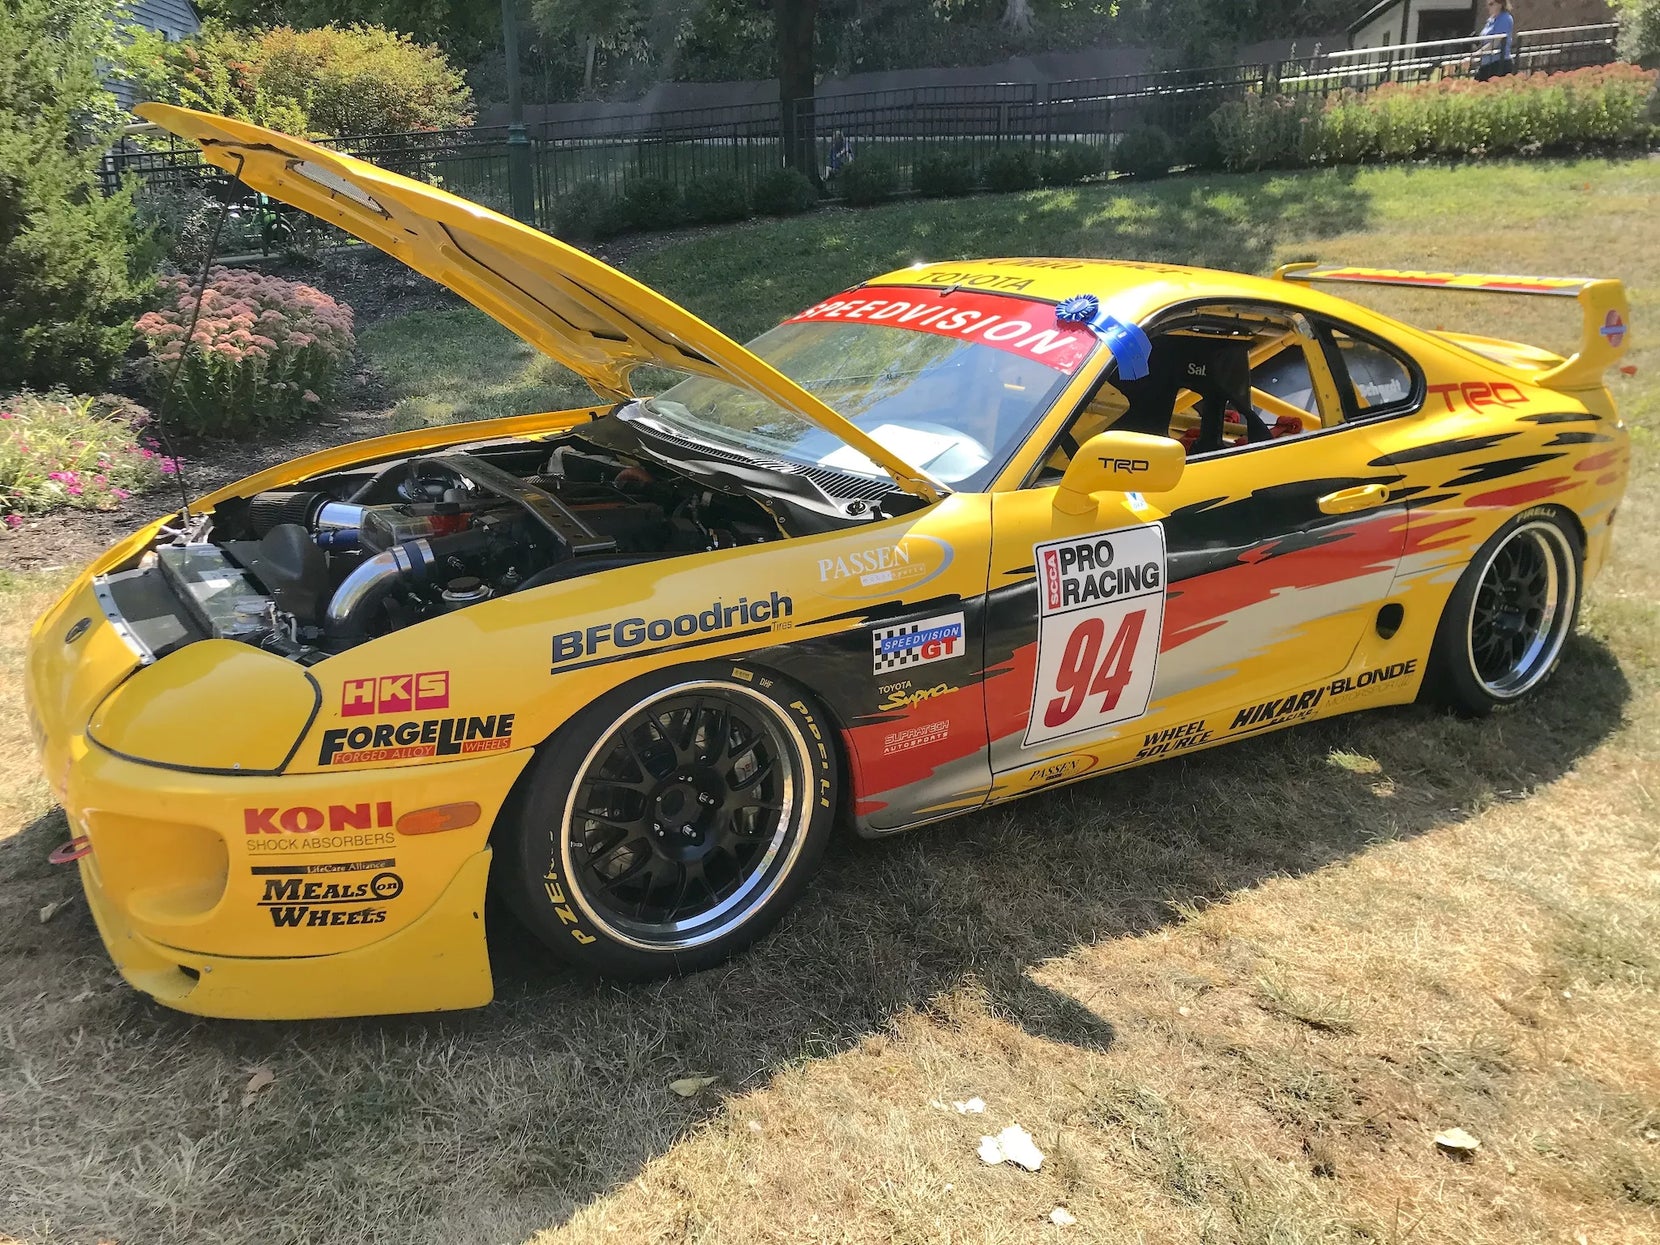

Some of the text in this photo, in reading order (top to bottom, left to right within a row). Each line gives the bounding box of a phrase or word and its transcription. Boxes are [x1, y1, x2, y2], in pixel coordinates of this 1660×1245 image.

[916, 272, 1036, 291] TOYOTA
[796, 300, 1078, 356] SPEEDVISION
[1428, 382, 1530, 414] TRD
[1098, 457, 1149, 474] TRD
[1516, 507, 1557, 523] PIRELLI
[817, 542, 910, 582] PASSEN
[1059, 540, 1114, 575] PRO
[1047, 552, 1060, 606] SCCA
[1062, 561, 1160, 606] RACING
[552, 591, 793, 664] BFGoodrich
[771, 620, 793, 632] Tires
[884, 626, 960, 651] SPEEDVISION
[921, 636, 957, 659] GT
[1044, 608, 1147, 728] 94
[1330, 659, 1417, 696] BLONDE
[342, 672, 449, 714] HKS
[878, 680, 912, 694] TOYOTA
[878, 683, 959, 709] Supra
[1229, 687, 1325, 730] HIKARI
[318, 713, 516, 766] FORGELINE
[884, 731, 949, 753] AUTOSPORTS
[1135, 730, 1214, 758] SOURCE
[1143, 720, 1205, 747] WHEEL
[335, 739, 509, 764] FORGED ALLOY WHEELS
[1029, 759, 1080, 781] PASSEN
[244, 801, 393, 835] KONI
[246, 832, 395, 851] SHOCK ABSORBERS
[262, 878, 368, 900] MEALS
[269, 906, 387, 927] WHEELS
